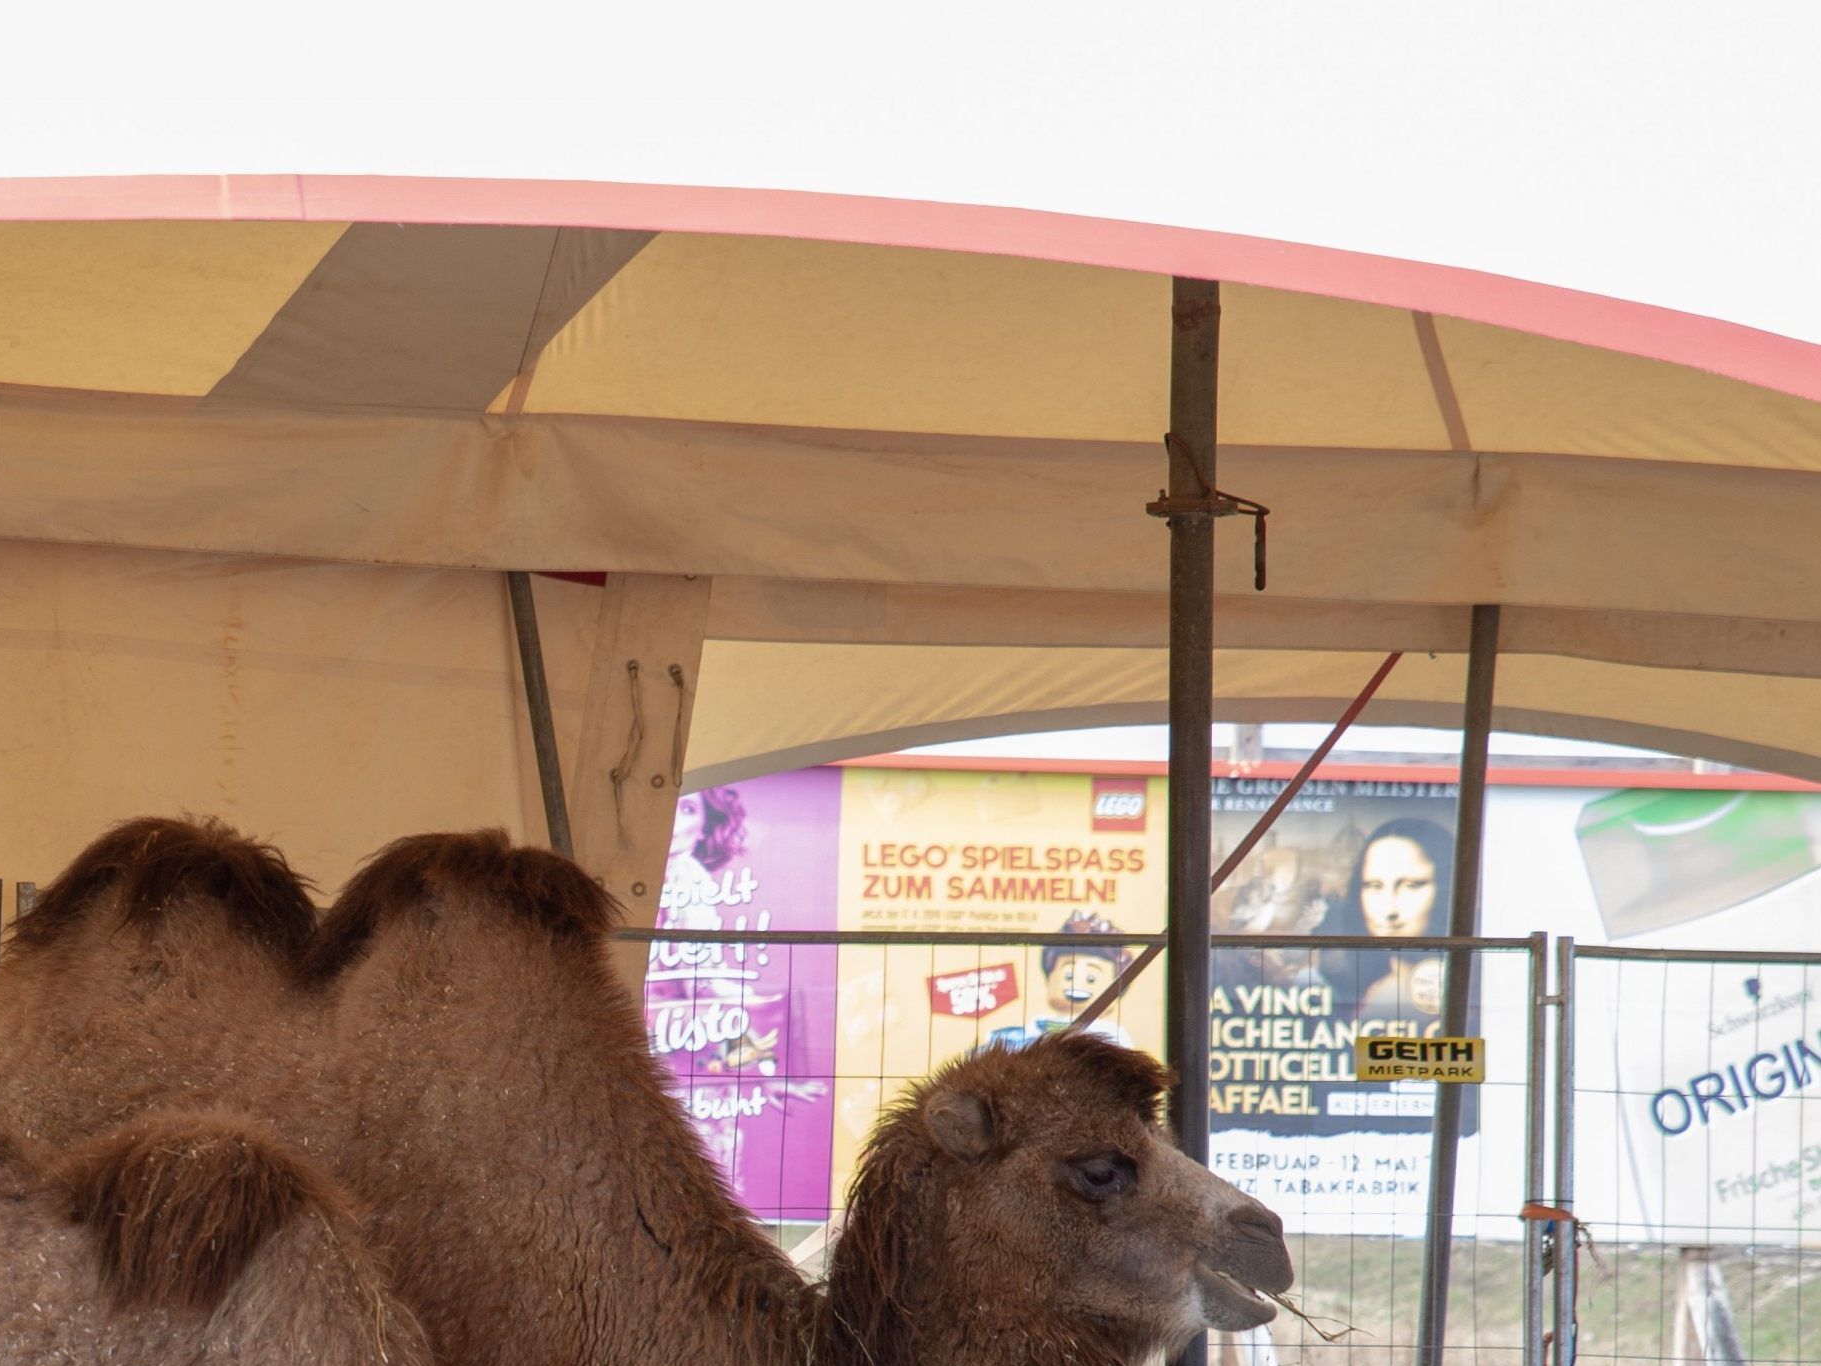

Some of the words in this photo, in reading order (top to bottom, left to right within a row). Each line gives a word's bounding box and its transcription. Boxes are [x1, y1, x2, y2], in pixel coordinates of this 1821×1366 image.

[1093, 794, 1144, 818] LEGO
[862, 843, 948, 869] LEGO
[961, 845, 1145, 873] SPIELSPASS
[862, 875, 932, 898] ZUM
[947, 876, 1116, 903] SAMMELN!
[1210, 985, 1233, 1014] A
[1235, 985, 1332, 1016] VINCI
[1368, 1040, 1473, 1062] GEITH
[1210, 1050, 1358, 1081] OTTICELL
[1368, 1065, 1473, 1077] MIETPARK
[1650, 1032, 1821, 1136] ORIGIN
[1209, 1084, 1321, 1115] AFFAEL
[1214, 1153, 1320, 1171] FEBRUAR
[1274, 1179, 1420, 1195] TABAKFABRIK
